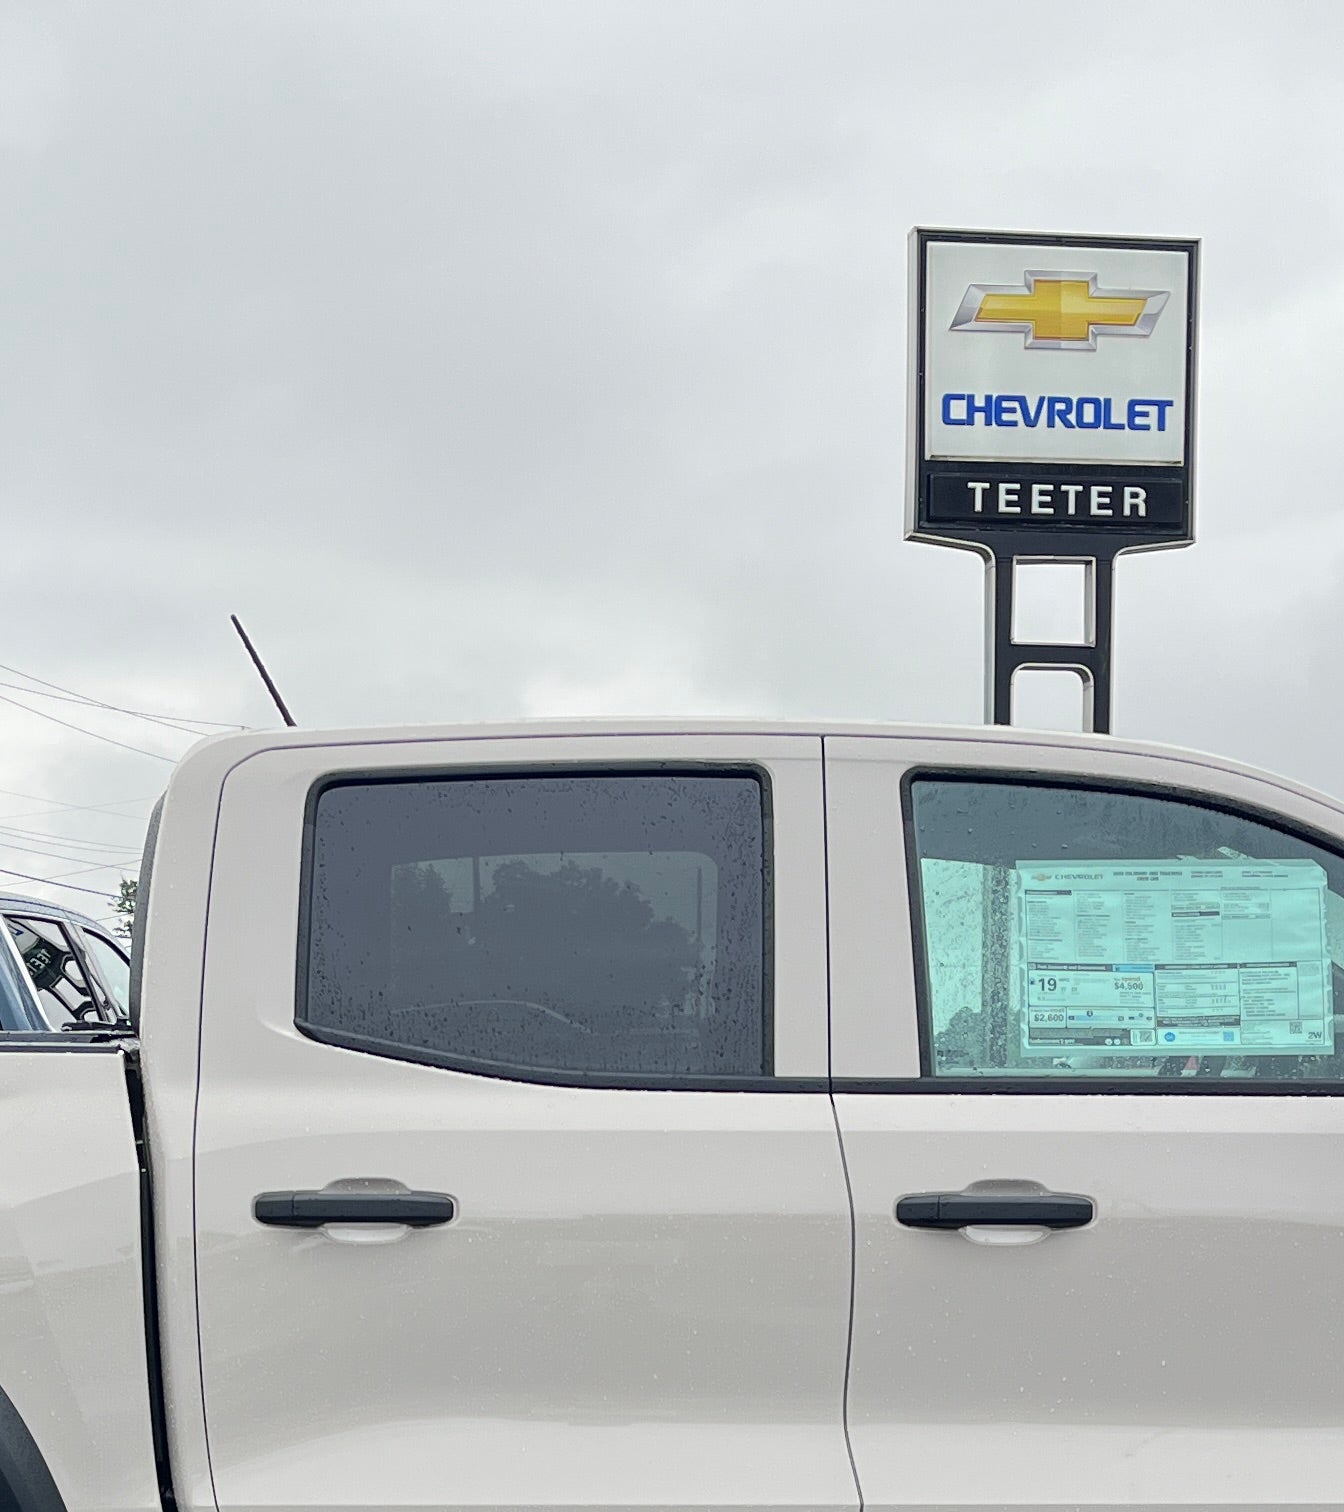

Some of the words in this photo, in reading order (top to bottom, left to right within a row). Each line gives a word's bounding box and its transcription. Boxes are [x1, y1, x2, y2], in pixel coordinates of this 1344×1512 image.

[941, 392, 1174, 431] CHEVROLET
[967, 481, 1147, 517] TEETER
[1038, 978, 1057, 992] 19
[1114, 981, 1144, 991] $4,500
[1033, 1013, 1064, 1022] $2,600
